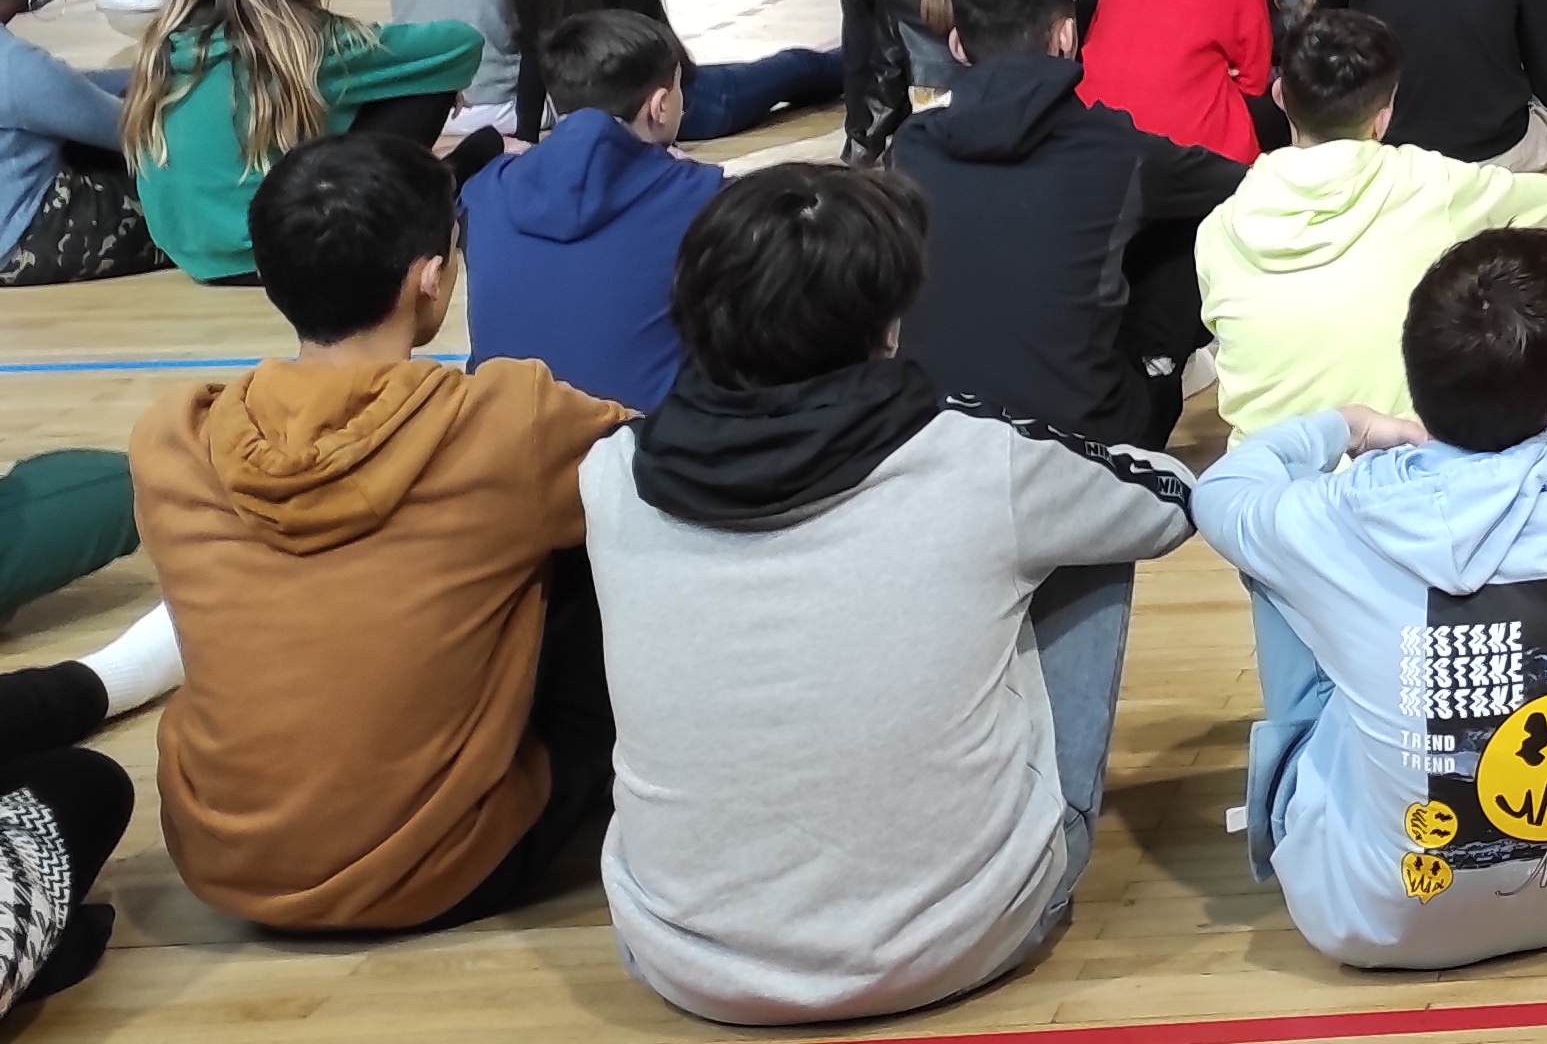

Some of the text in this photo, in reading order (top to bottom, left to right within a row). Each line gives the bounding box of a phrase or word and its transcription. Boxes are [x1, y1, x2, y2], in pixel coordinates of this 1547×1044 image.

[1399, 621, 1523, 657] MISTAKE
[1399, 652, 1524, 688] MISTAKE
[1399, 683, 1525, 719] MISTAKE
[1400, 729, 1456, 752] TREND
[1400, 751, 1457, 774] TREND
